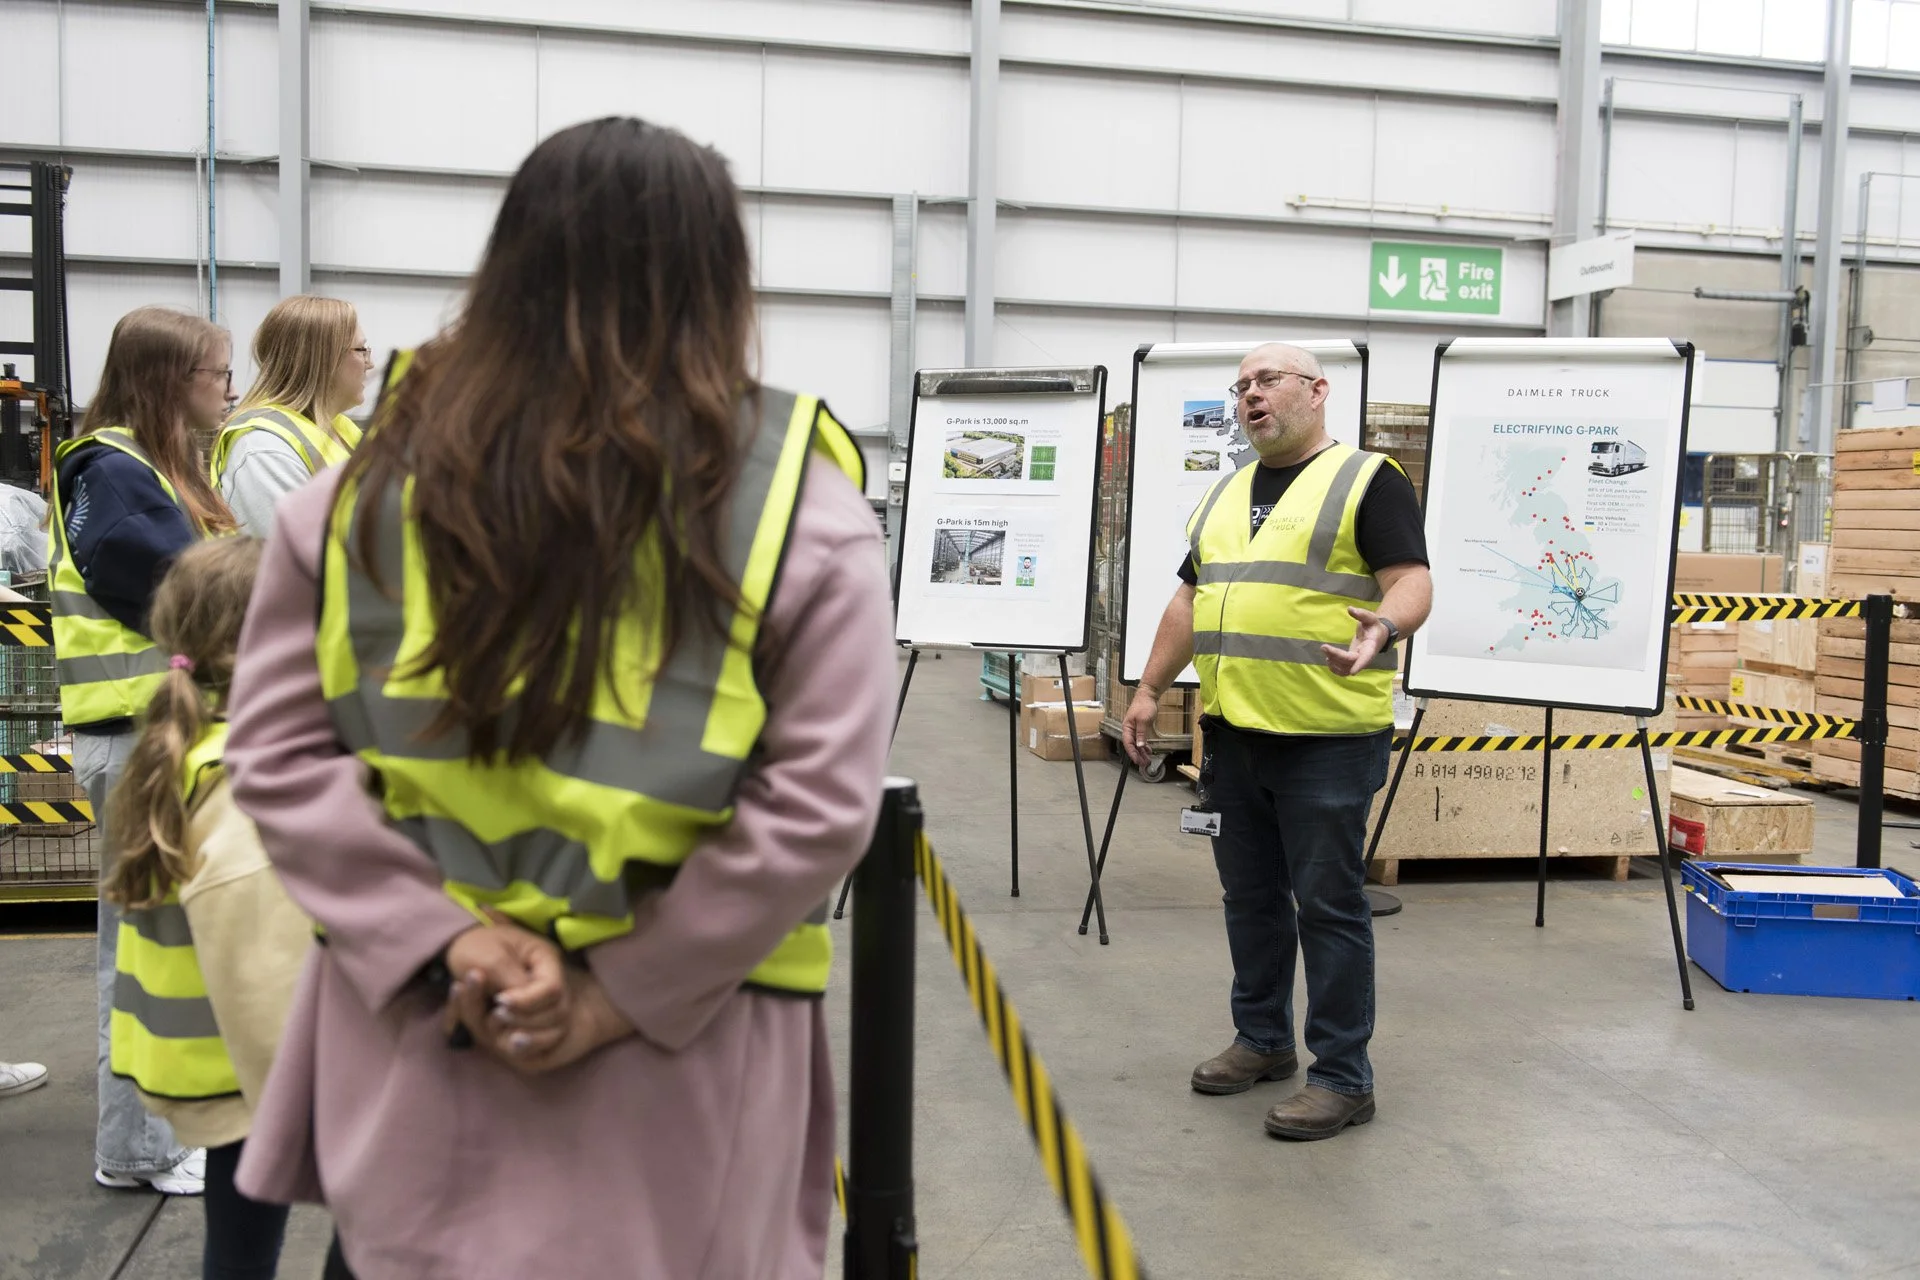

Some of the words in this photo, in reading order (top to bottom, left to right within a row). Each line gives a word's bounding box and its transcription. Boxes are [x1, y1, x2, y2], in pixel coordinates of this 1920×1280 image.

[1458, 262, 1495, 281] Fire
[1580, 261, 1615, 275] Outbound
[1458, 283, 1494, 300] exit
[1507, 388, 1563, 397] DAIMLER
[1571, 388, 1610, 398] TRUCK
[982, 418, 1007, 426] 13,000
[1008, 419, 1029, 427] sq.m
[1493, 424, 1573, 435] ELECTRIFYING
[1576, 425, 1620, 436] G-PARK
[937, 518, 963, 526] G-Park
[991, 519, 1009, 528] high
[1415, 763, 1425, 778] A
[1431, 764, 1457, 779] 014
